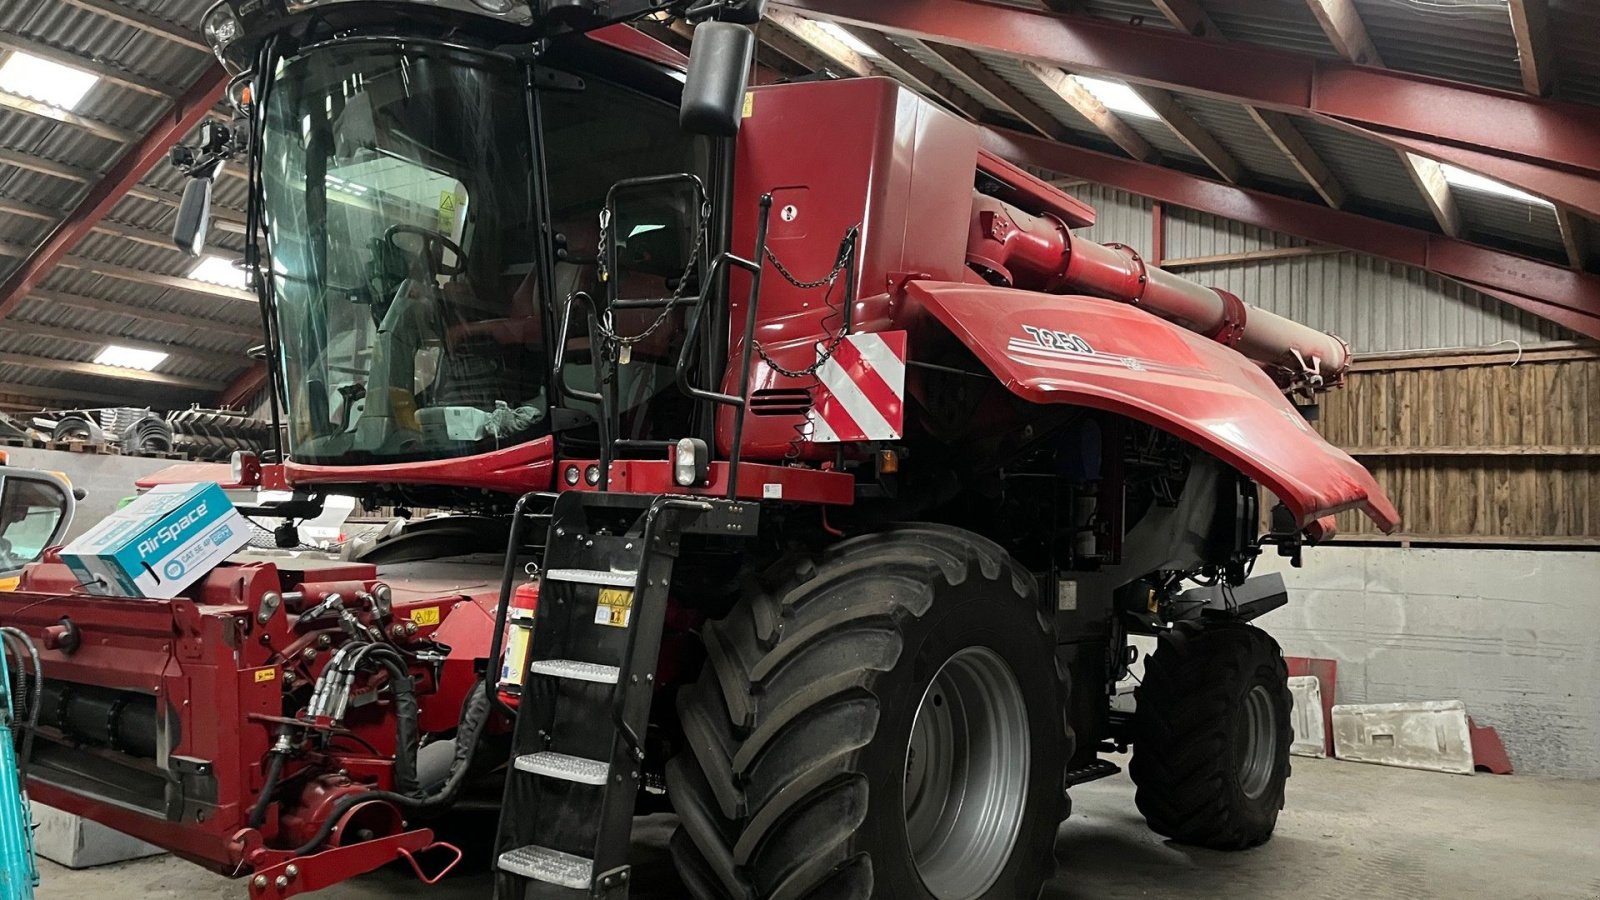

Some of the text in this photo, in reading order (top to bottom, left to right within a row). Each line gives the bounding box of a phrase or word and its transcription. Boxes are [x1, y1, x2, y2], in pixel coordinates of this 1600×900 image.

[1021, 324, 1095, 355] 7250
[137, 503, 208, 558] AirSpace
[181, 551, 194, 563] CAT
